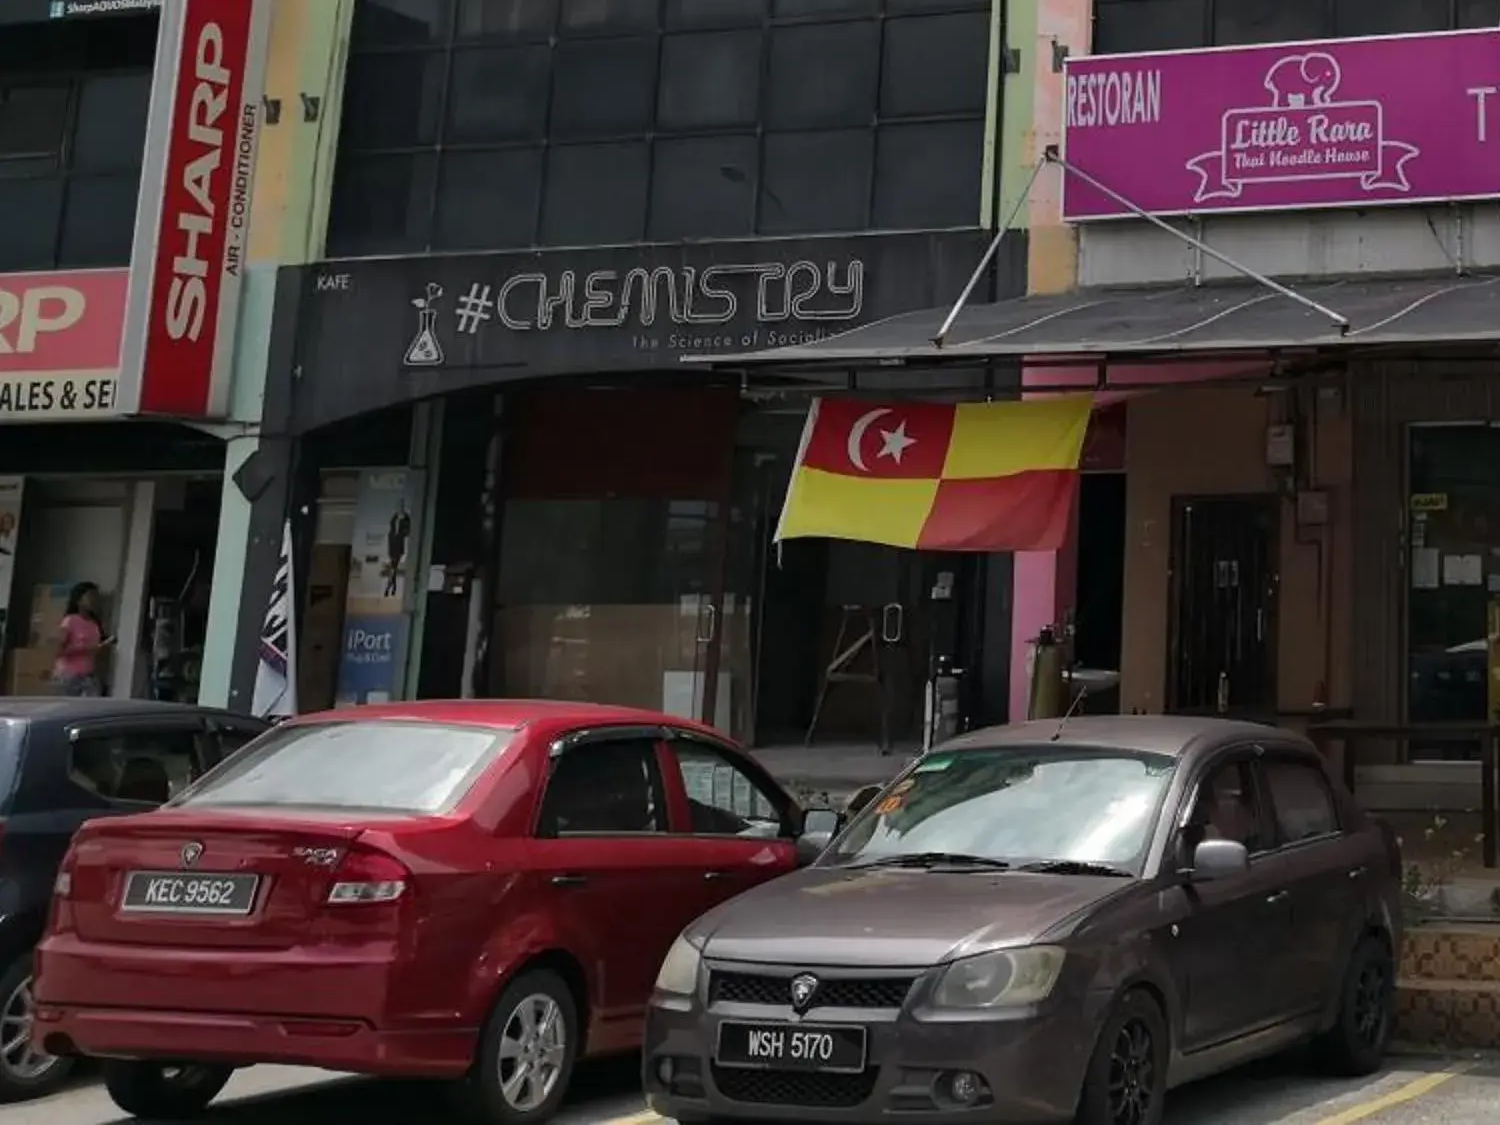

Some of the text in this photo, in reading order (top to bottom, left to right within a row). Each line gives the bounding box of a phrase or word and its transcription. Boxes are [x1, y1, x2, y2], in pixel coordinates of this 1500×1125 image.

[1067, 69, 1161, 127] RESTORAN
[1231, 114, 1373, 149] Little Rara
[230, 103, 257, 228] CONDITIONER
[1233, 147, 1370, 169] Thai Noodle House
[166, 22, 231, 343] SHARP
[225, 248, 240, 276] AIR
[317, 273, 351, 291] KAFE
[668, 333, 733, 348] Science
[741, 331, 759, 347] of
[0, 378, 118, 412] ALES & SE
[145, 878, 235, 904] KEC 9562
[748, 1030, 833, 1060] WSH 5170
